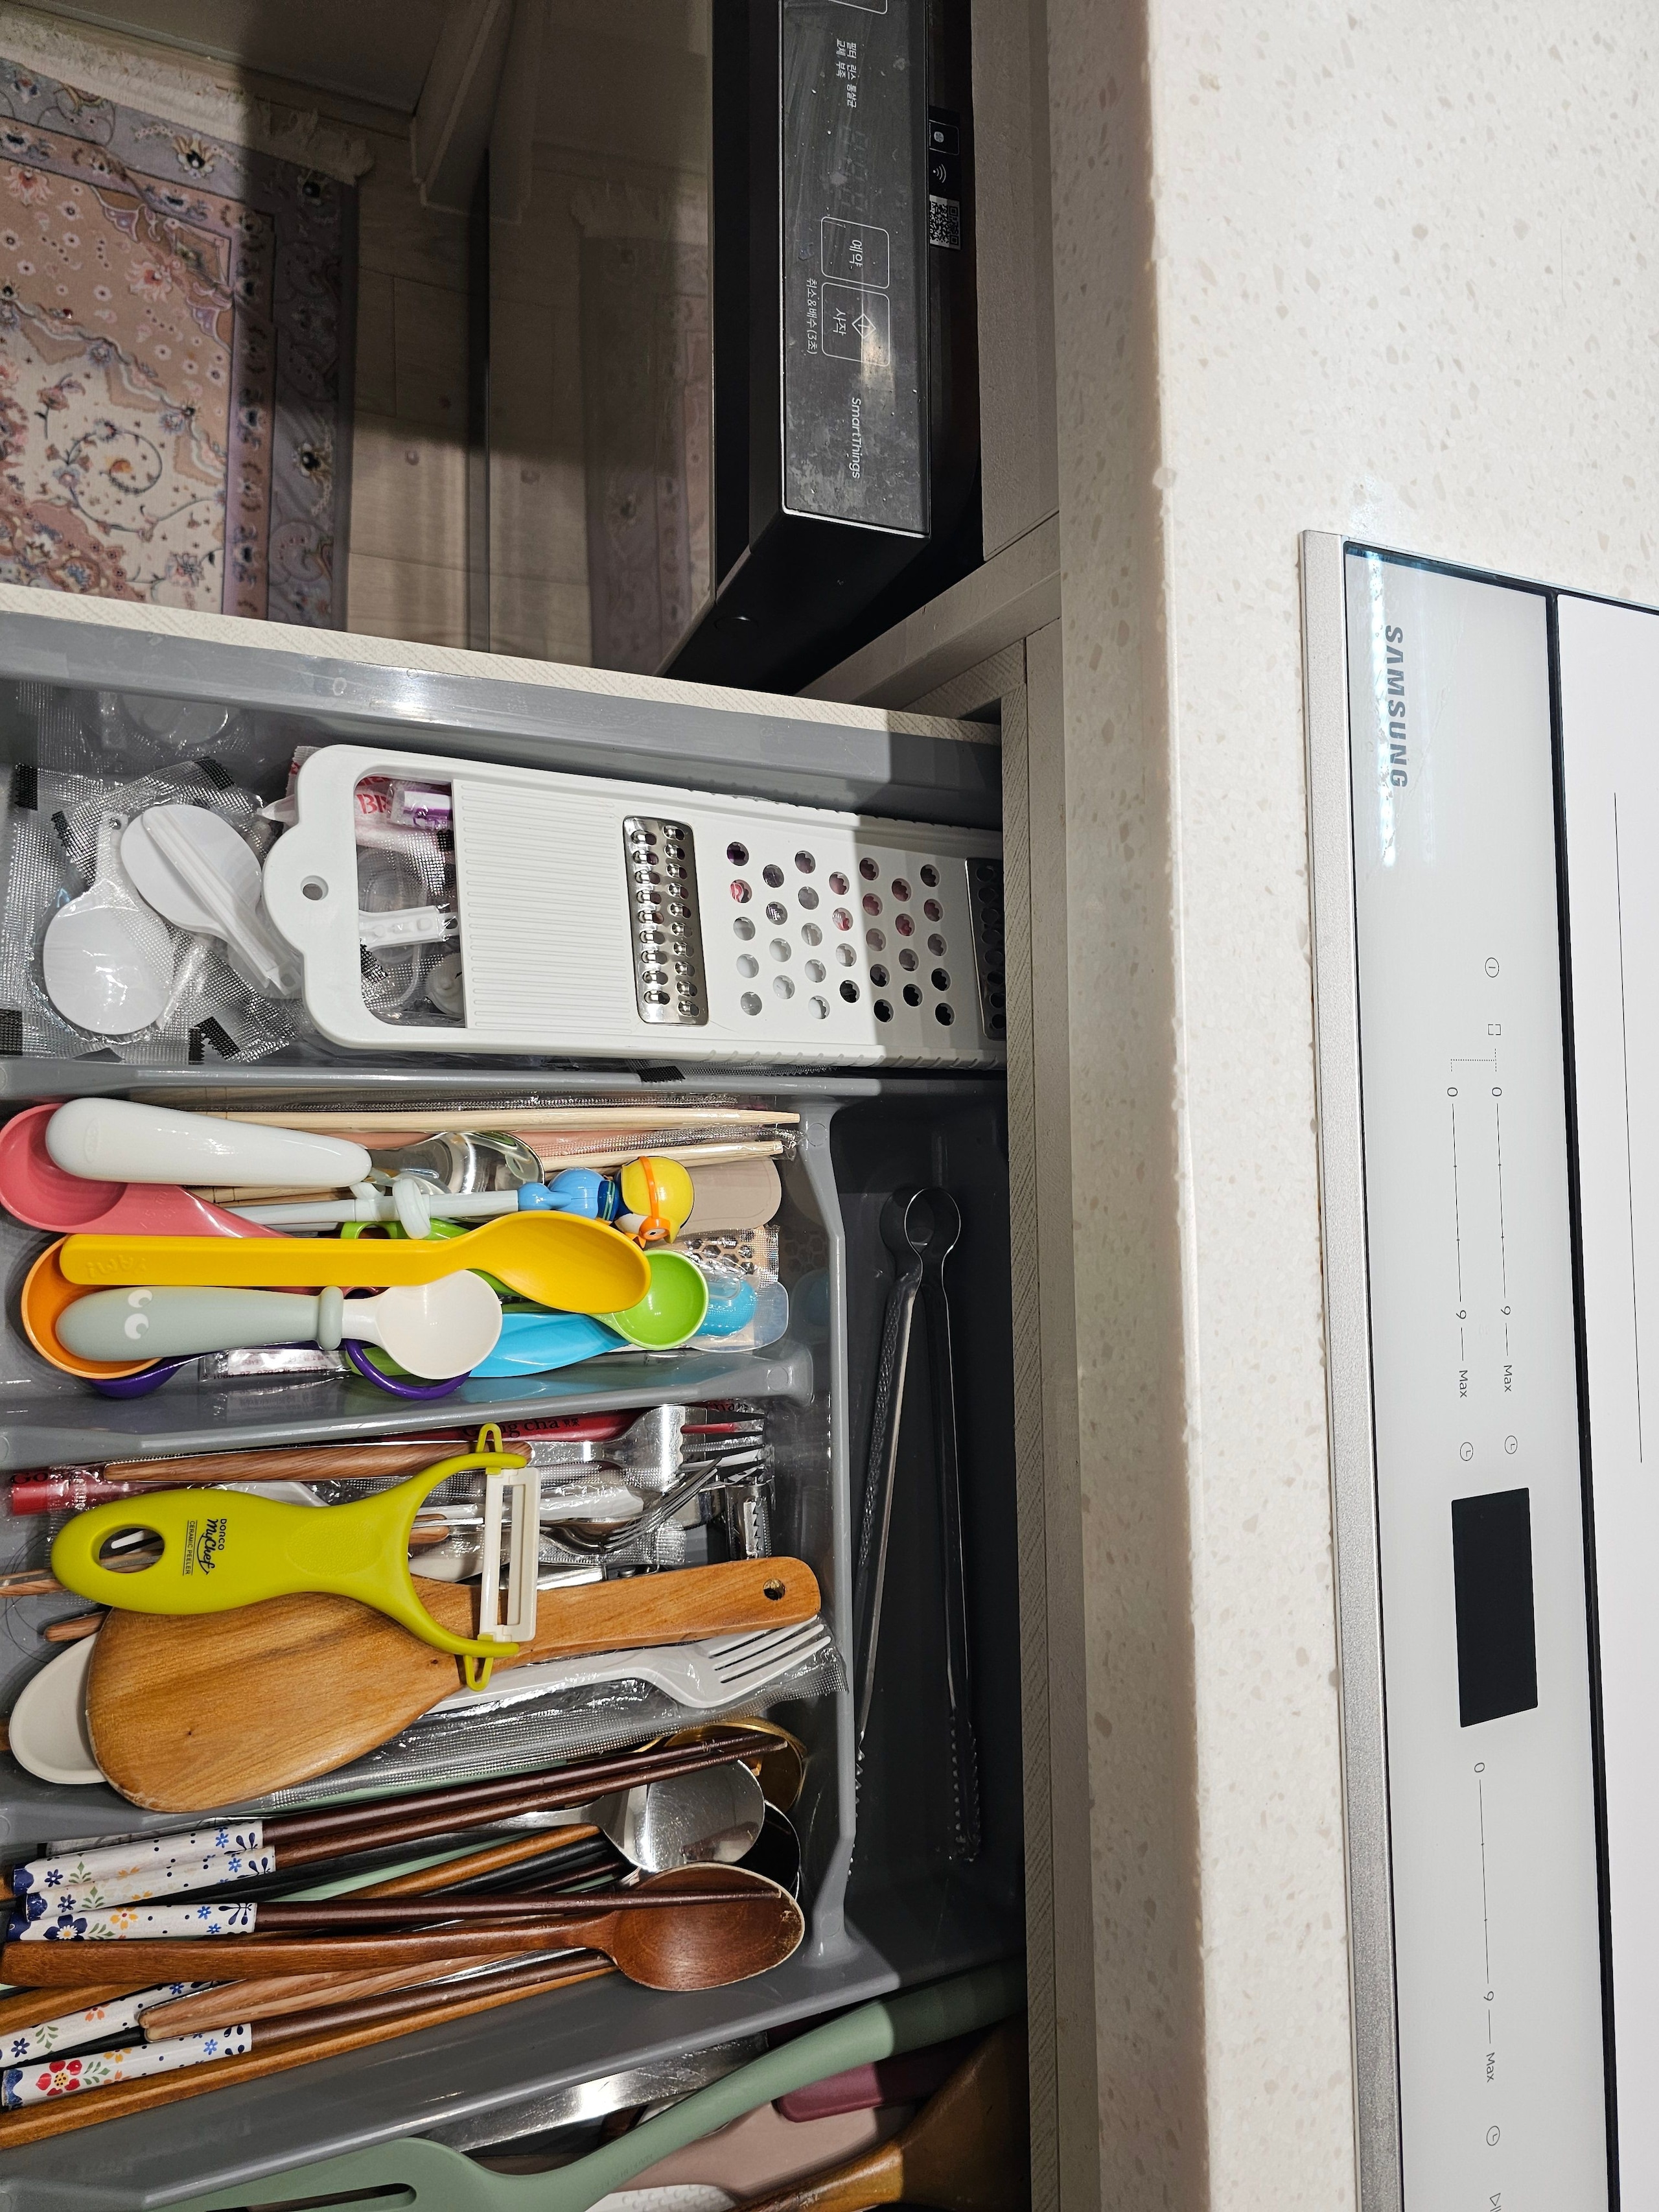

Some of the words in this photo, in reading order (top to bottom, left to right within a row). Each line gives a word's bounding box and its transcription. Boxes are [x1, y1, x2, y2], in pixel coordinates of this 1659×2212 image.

[836, 39, 846, 56] 교체
[847, 42, 857, 59] 필터
[836, 62, 846, 78] 부족
[847, 64, 857, 80] 린스
[847, 84, 857, 108] 통살균
[850, 240, 863, 267] 예약
[849, 397, 863, 478] SmartThings
[1386, 625, 1408, 787] SAMSUNG
[1456, 1310, 1466, 1320] 9
[1501, 1306, 1511, 1316] 9
[1459, 1369, 1468, 1398] Max
[1503, 1365, 1513, 1393] Max
[462, 1422, 520, 1438] Gng
[524, 1419, 560, 1431] cha
[197, 1519, 218, 1574] MyChef
[218, 1519, 227, 1550] DORCO
[1484, 1991, 1494, 2001] 9
[1486, 2052, 1496, 2083] Max
